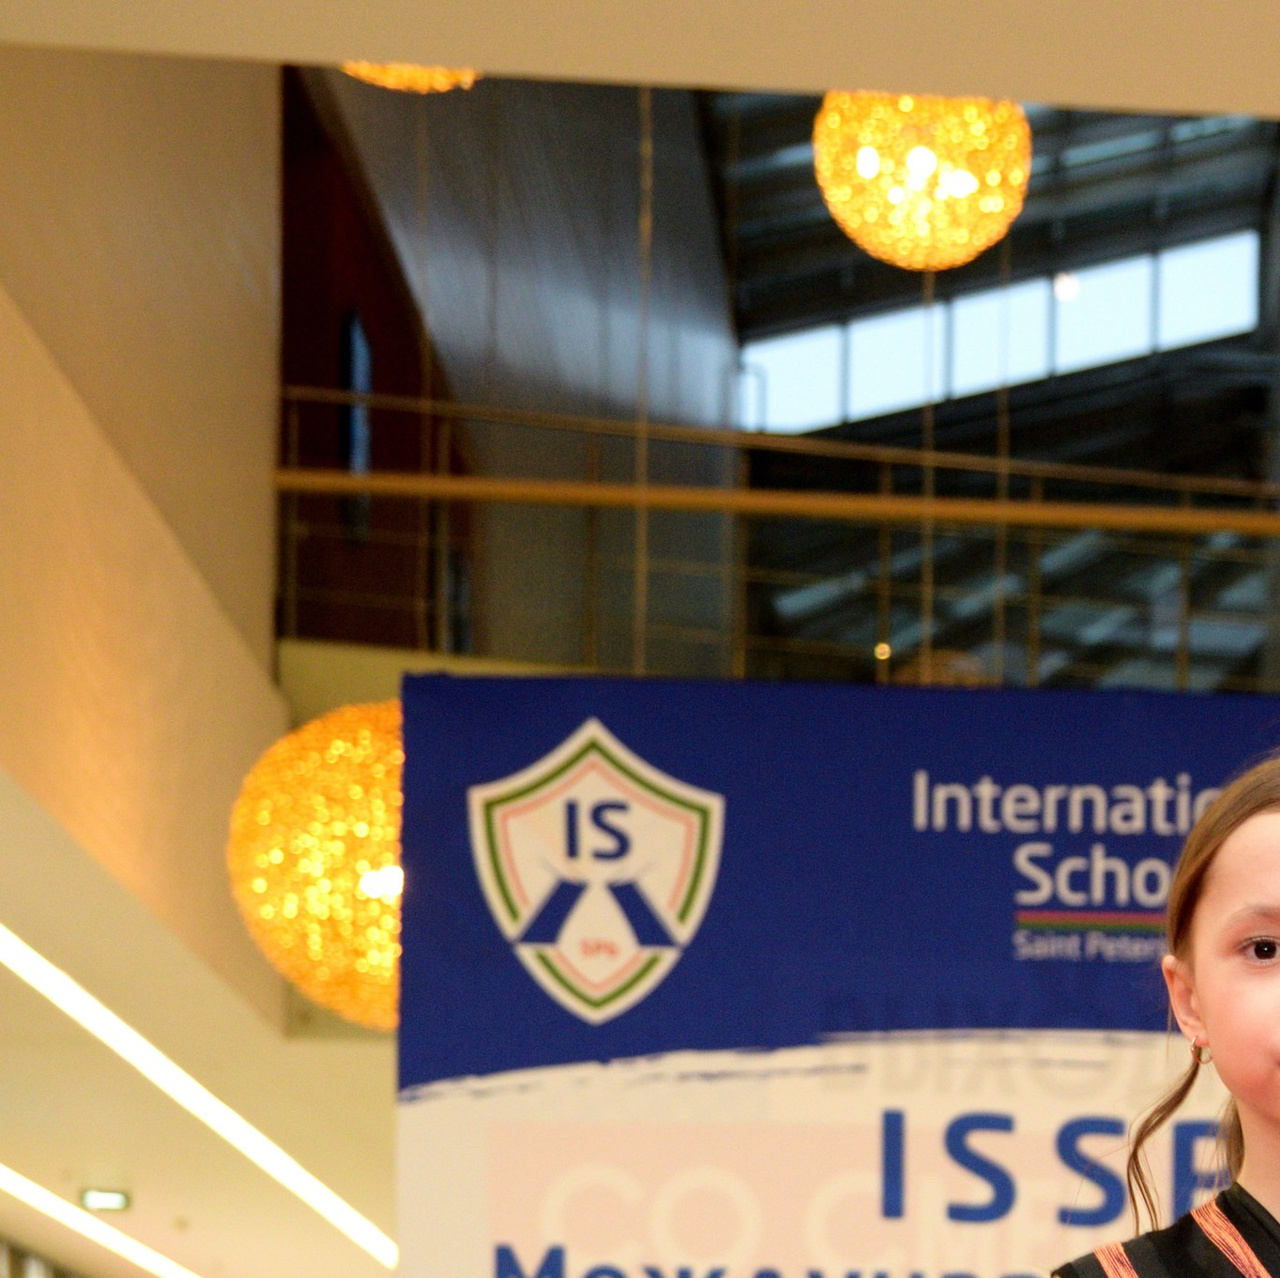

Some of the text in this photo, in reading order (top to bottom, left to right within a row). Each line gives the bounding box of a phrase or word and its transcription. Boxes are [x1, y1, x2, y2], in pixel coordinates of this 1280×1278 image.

[563, 799, 632, 862] IS
[1013, 841, 1173, 908] Scho
[1013, 930, 1081, 962] Saint
[880, 1109, 1258, 1228] ISSP
